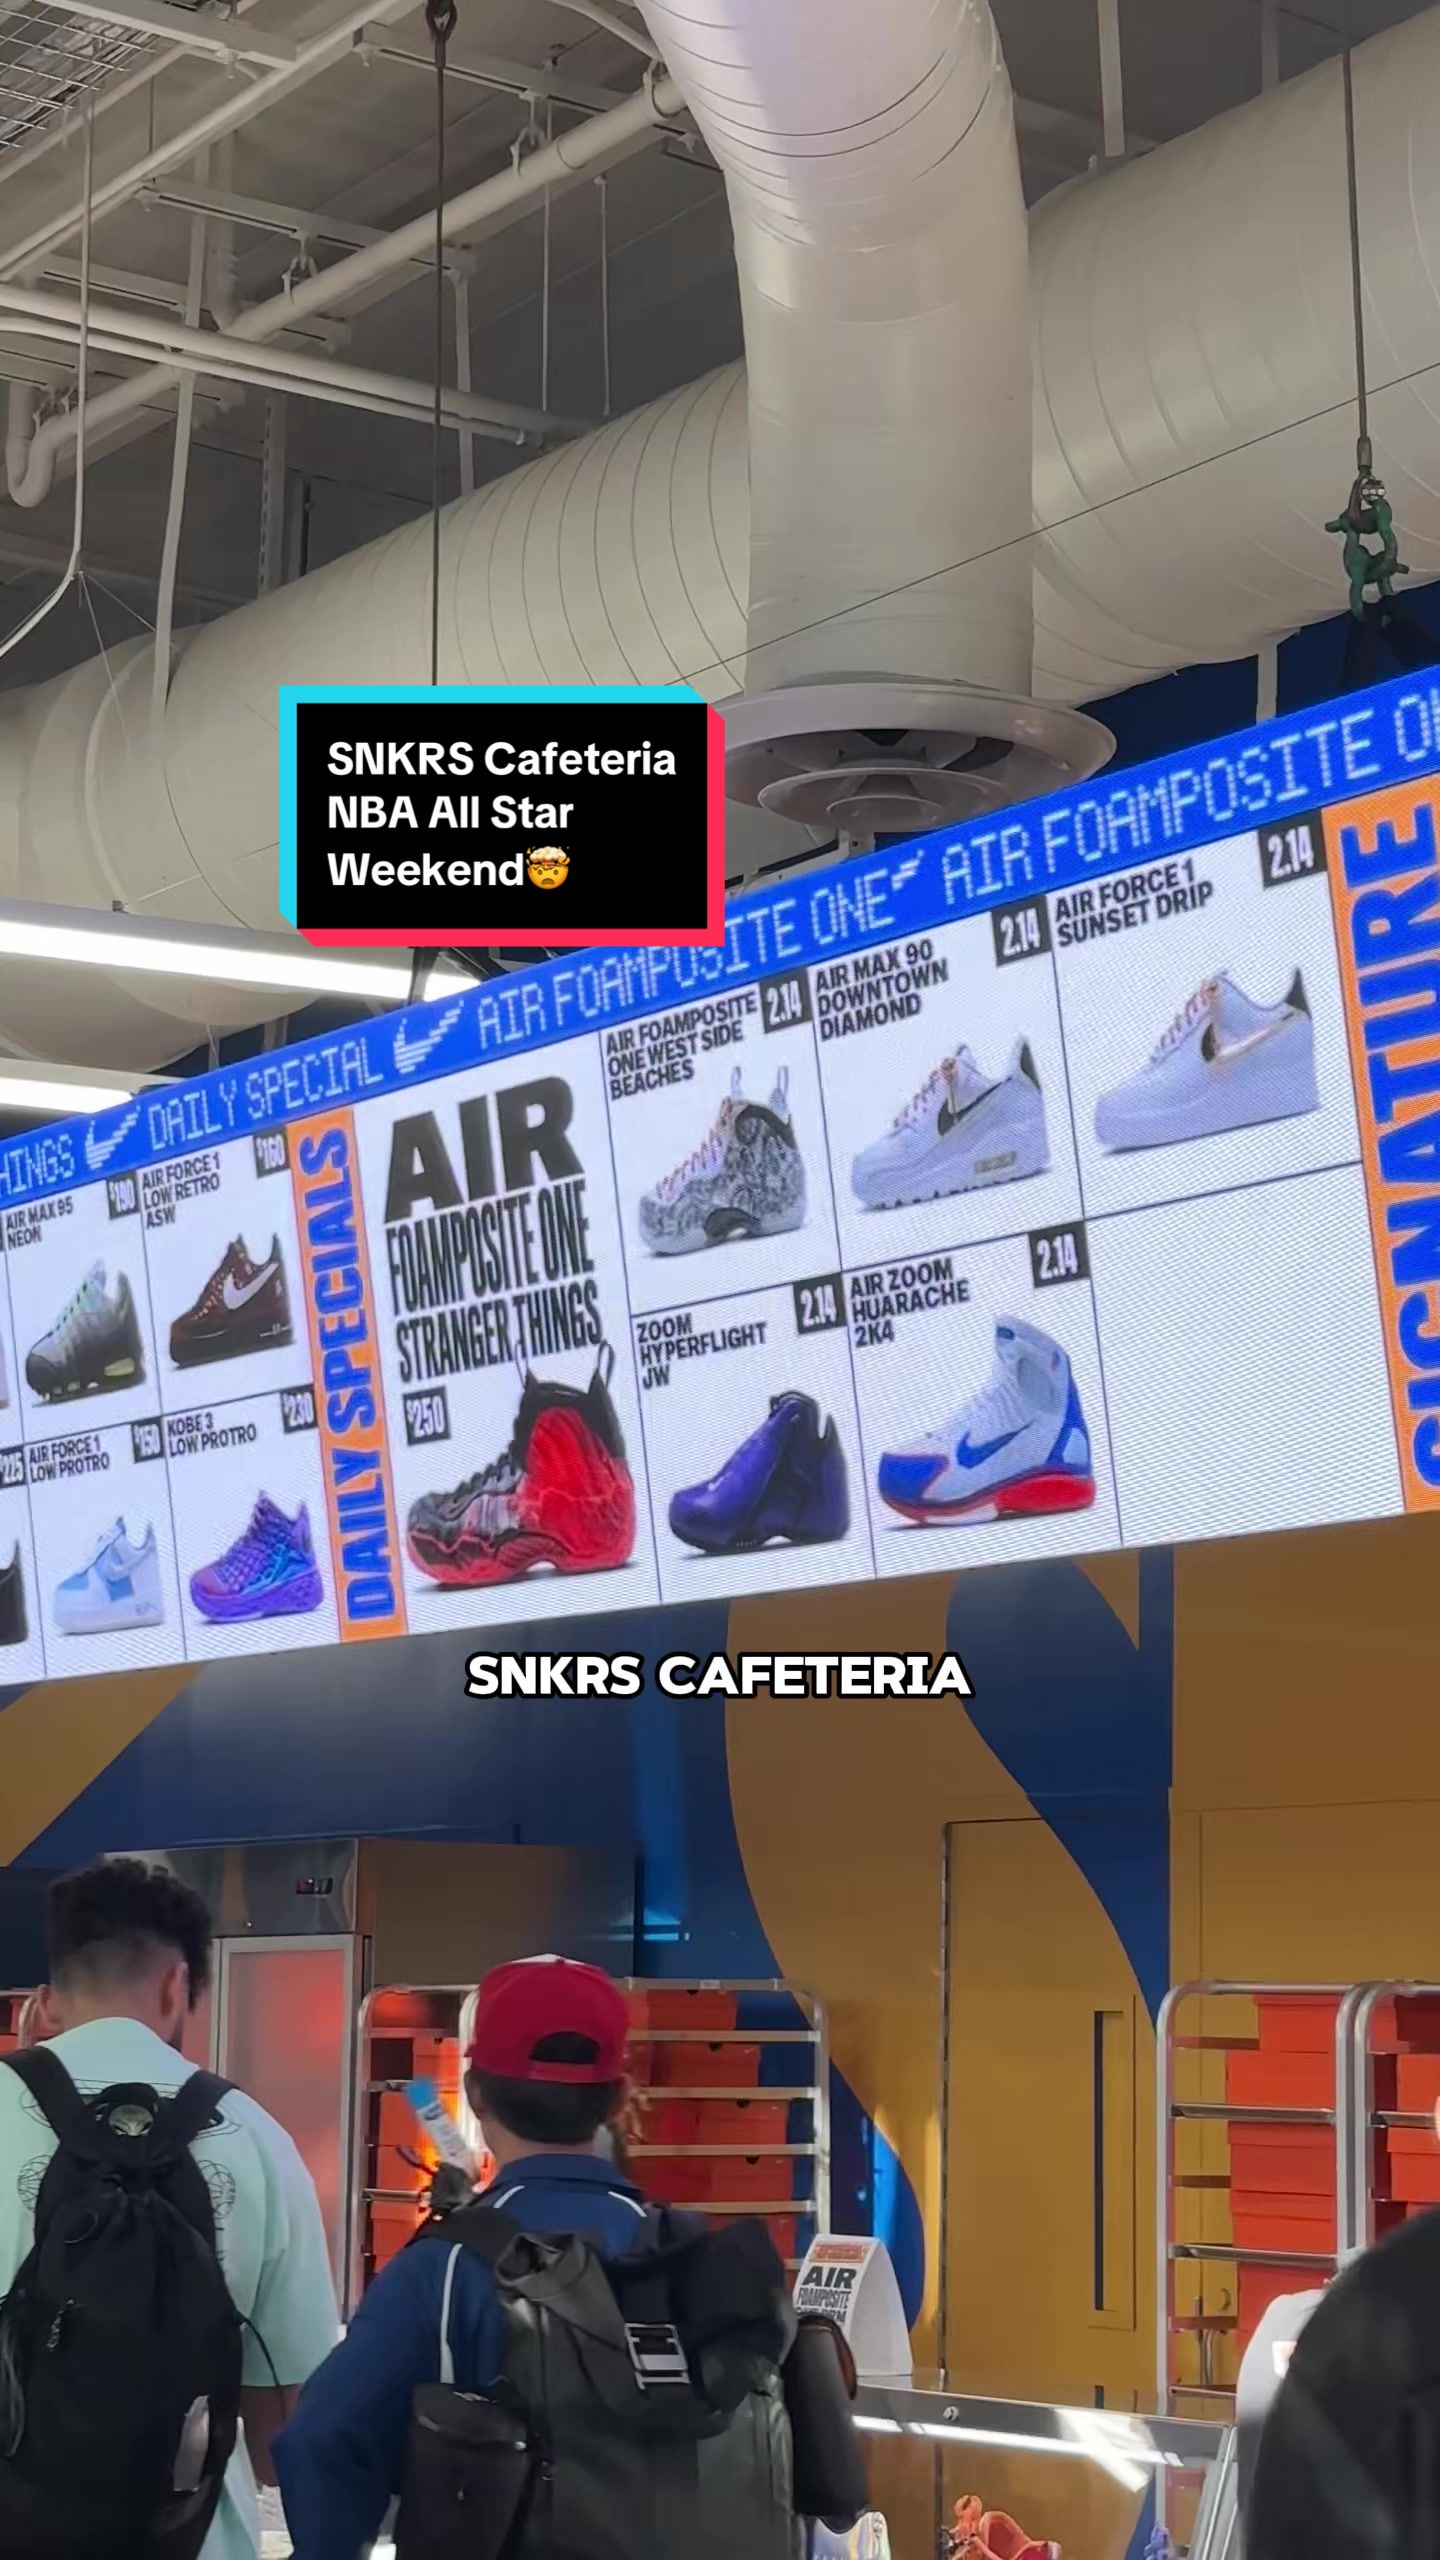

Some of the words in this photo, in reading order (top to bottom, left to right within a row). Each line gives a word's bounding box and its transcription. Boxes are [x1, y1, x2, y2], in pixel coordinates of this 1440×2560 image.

[941, 824, 1034, 904] AIR
[1042, 709, 1381, 874] FOAMPOSITE
[1267, 825, 1315, 879] 2.14
[1055, 893, 1094, 922] AIR
[1099, 863, 1179, 907] FORCE
[1181, 858, 1195, 883] 1
[1000, 907, 1042, 957] 2.14
[1057, 900, 1150, 948] SUNSET
[1157, 880, 1214, 919] DRIP
[478, 982, 547, 1050] AIR
[810, 868, 895, 945] ONE
[815, 964, 849, 993] AIR
[854, 947, 901, 980] MAX
[906, 938, 934, 965] 90
[767, 980, 802, 1026] 2.14
[817, 957, 949, 1017] DOWNTOWN
[606, 1029, 634, 1057] AIR
[639, 991, 758, 1044] FOAMPOSITE
[820, 993, 921, 1042] DIAMOND
[607, 1050, 646, 1077] ONE
[647, 1032, 698, 1066] WEST
[701, 1020, 743, 1051] SIDE
[148, 1079, 237, 1151] DAILY
[246, 1037, 384, 1120] SPECIAL
[610, 1058, 695, 1100] BEACHES
[142, 1169, 165, 1191] AIR
[166, 1154, 211, 1183] FORCE
[212, 1152, 221, 1171] 1
[384, 1076, 585, 1224] AIR
[7, 1210, 27, 1231] AIR
[28, 1201, 56, 1224] MAX
[57, 1195, 74, 1216] 95
[143, 1185, 174, 1210] LOW
[175, 1173, 220, 1201] RETRO
[8, 1225, 42, 1249] NEON
[146, 1205, 176, 1230] ASW
[385, 1191, 539, 1316] FOAMPOSITE
[538, 1178, 595, 1282] ONE
[1037, 1233, 1078, 1280] 2.14
[299, 1128, 377, 1433] SPECIALS
[850, 1271, 883, 1299] AIR
[888, 1256, 953, 1292] ZOOM
[801, 1284, 837, 1327] 2.14
[852, 1280, 970, 1324] HUARACHE
[395, 1299, 514, 1383] STRANGER
[512, 1278, 603, 1358] THINGS
[636, 1312, 693, 1344] ZOOM
[640, 1321, 767, 1366] HYPERFLIGHT
[855, 1319, 895, 1348] 2K4
[642, 1364, 670, 1390] JW
[167, 1414, 203, 1437] KOBE
[205, 1411, 214, 1430] 3
[407, 1396, 445, 1438] $250
[29, 1444, 49, 1464] AIR
[52, 1435, 92, 1461] FORCE
[94, 1434, 101, 1452] 1
[169, 1434, 199, 1458] LOW
[200, 1423, 257, 1452] PROTRO
[30, 1462, 57, 1483] LOW
[59, 1452, 111, 1478] PROTRO
[331, 1448, 396, 1620] DAILY
[802, 2266, 857, 2289] AIR
